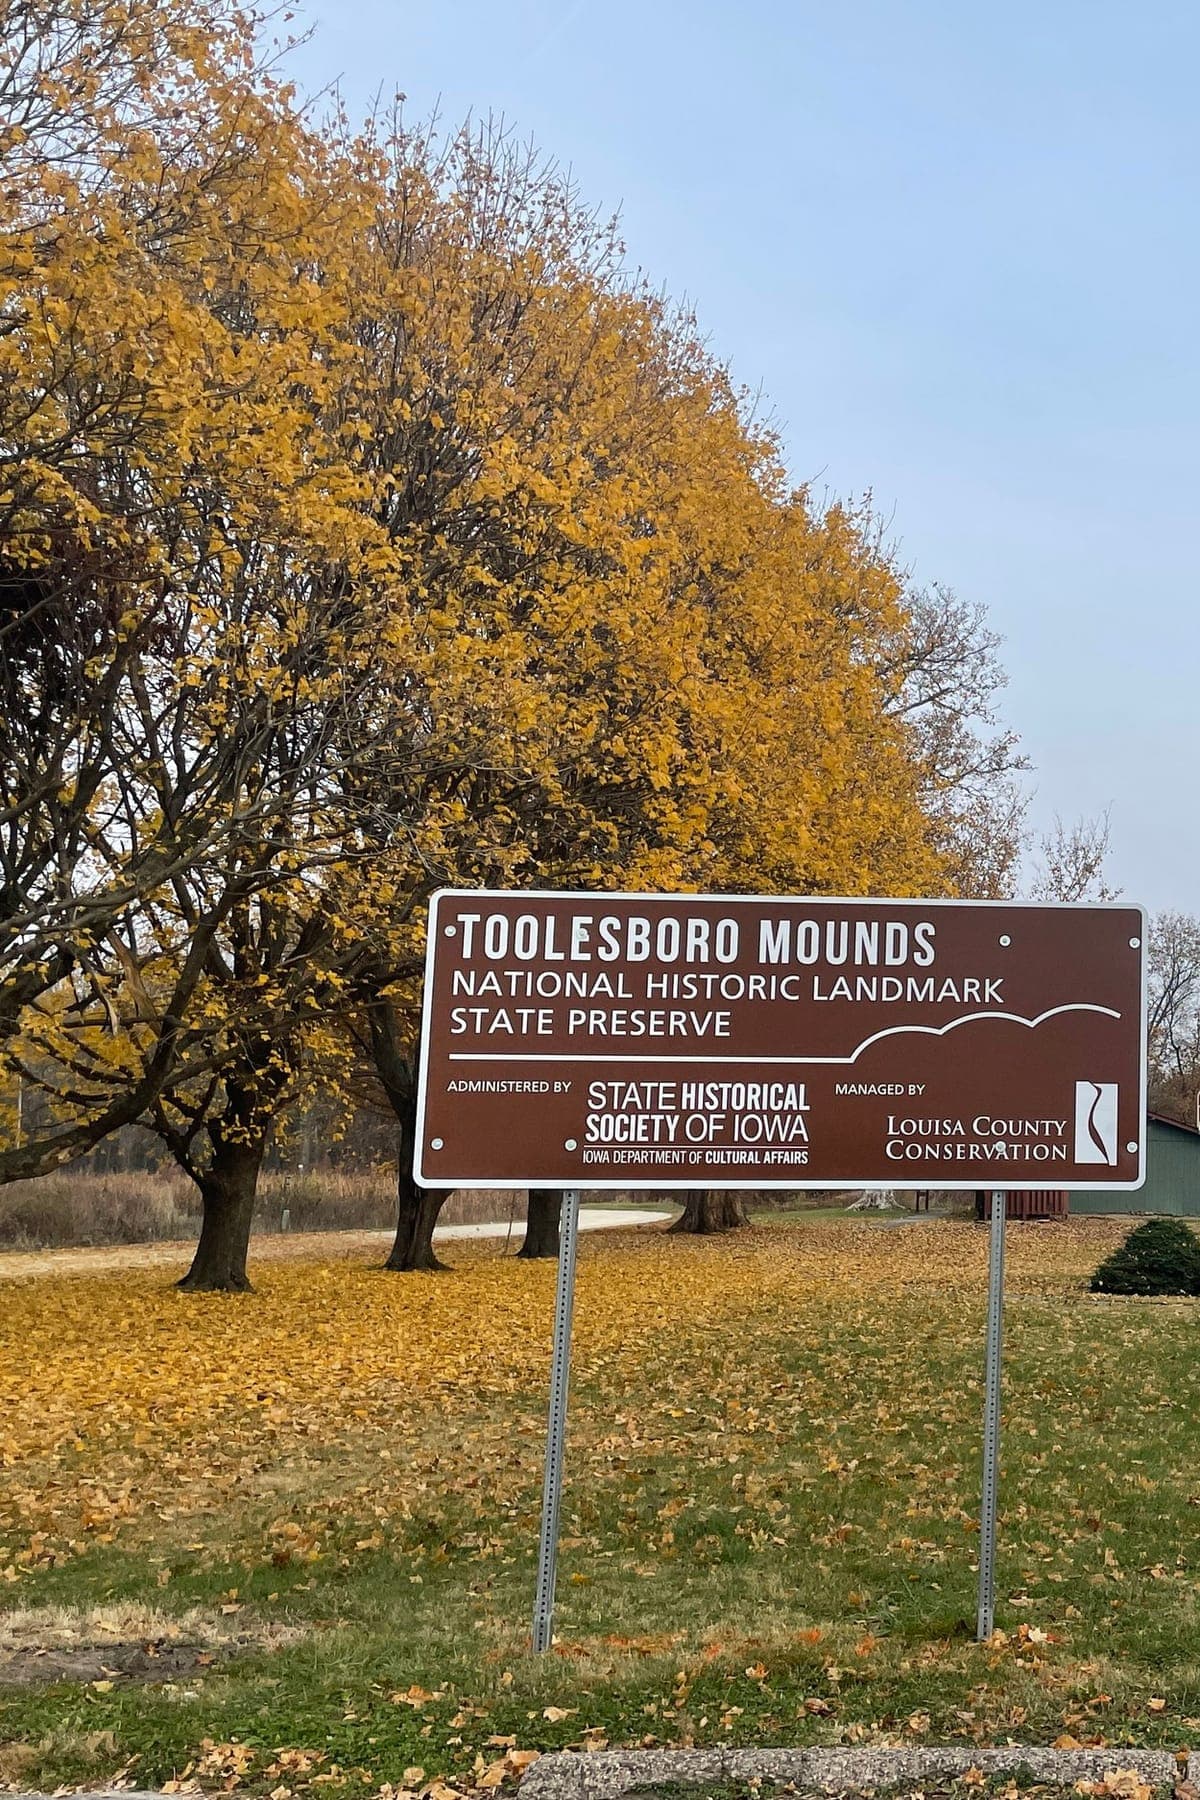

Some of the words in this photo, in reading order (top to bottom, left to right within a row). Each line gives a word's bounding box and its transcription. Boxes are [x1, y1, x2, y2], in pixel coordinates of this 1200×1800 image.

[457, 914, 739, 963] TOOLESBORO
[760, 920, 936, 967] MOUNDS
[452, 970, 632, 999] NATIONAL
[647, 974, 800, 1001] HISTORIC
[813, 976, 1004, 1003] LANDMARK
[451, 1008, 553, 1035] STATE
[569, 1010, 731, 1036] PRESERVE
[447, 1080, 549, 1093] ADMINISTERED
[554, 1081, 572, 1093] BY
[588, 1081, 676, 1110] STATE
[682, 1083, 810, 1111] HISTORICAL
[835, 1084, 904, 1095] MANAGED
[908, 1085, 925, 1096] BY
[585, 1114, 679, 1142] SOCIETY
[685, 1114, 725, 1142] OF
[734, 1115, 809, 1142] IOWA
[583, 1150, 609, 1163] IOWA
[613, 1150, 686, 1164] DEPARTMENT
[688, 1152, 703, 1164] OF
[705, 1151, 760, 1164] CULTURAL
[763, 1151, 808, 1165] AFFAIRS
